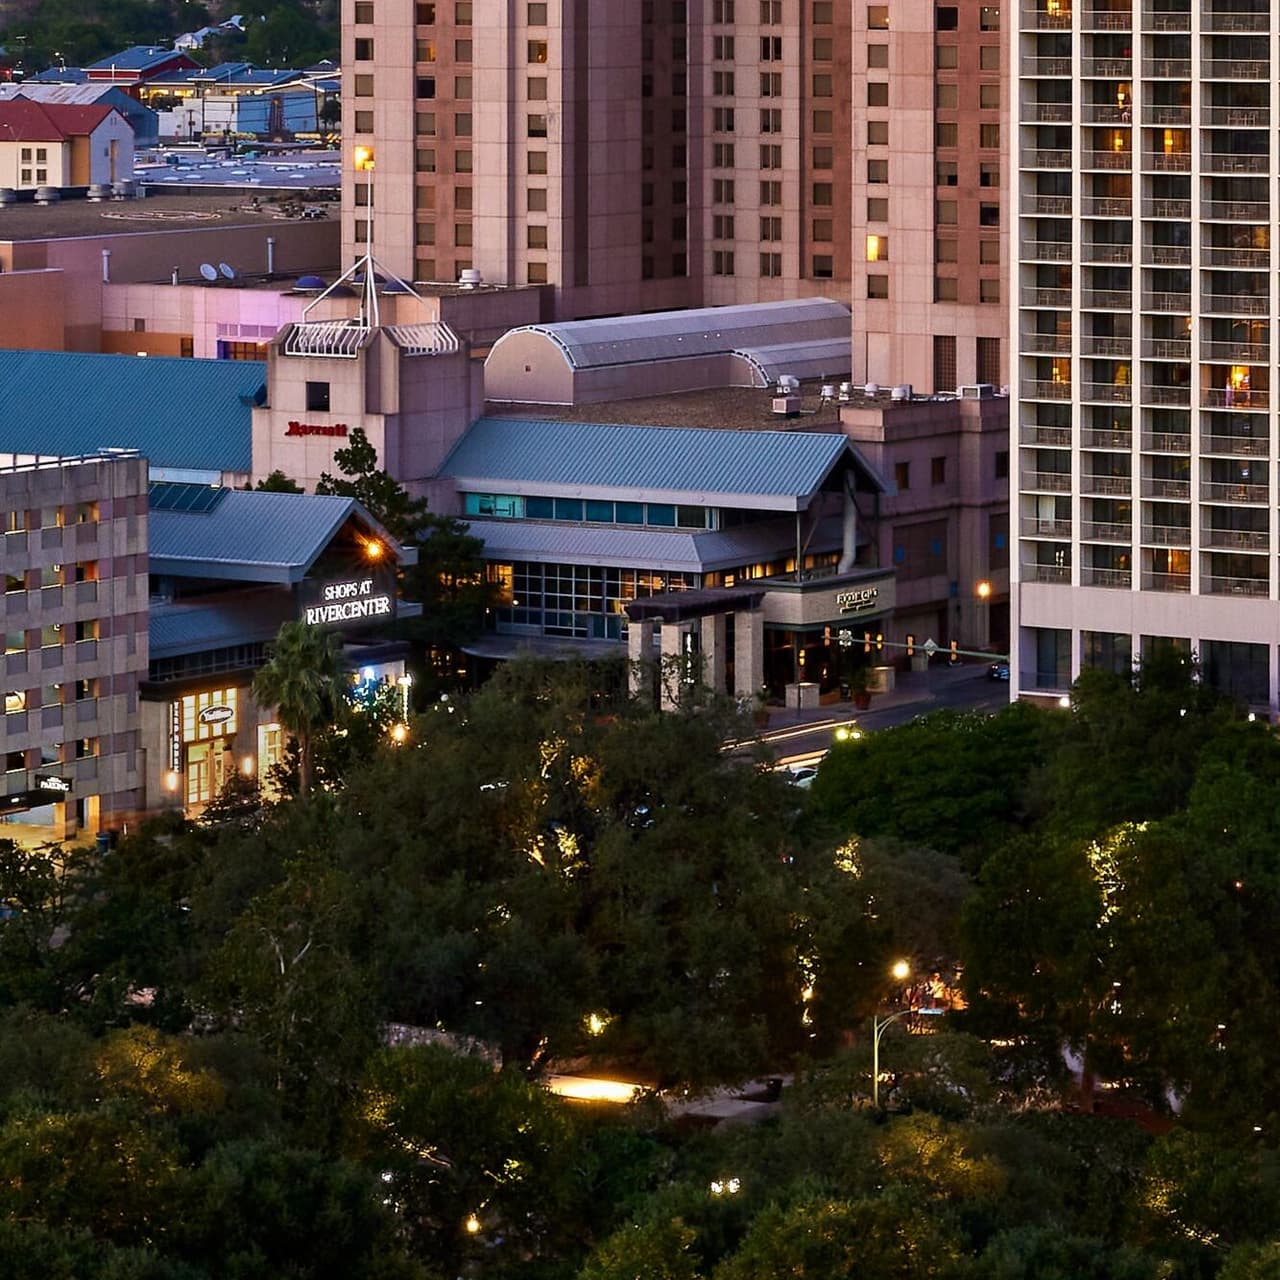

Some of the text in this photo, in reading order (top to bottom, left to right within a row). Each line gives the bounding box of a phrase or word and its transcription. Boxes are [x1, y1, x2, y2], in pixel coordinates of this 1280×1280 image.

[324, 580, 373, 600] SHOPS AT
[306, 596, 390, 625] RIVERCENTER
